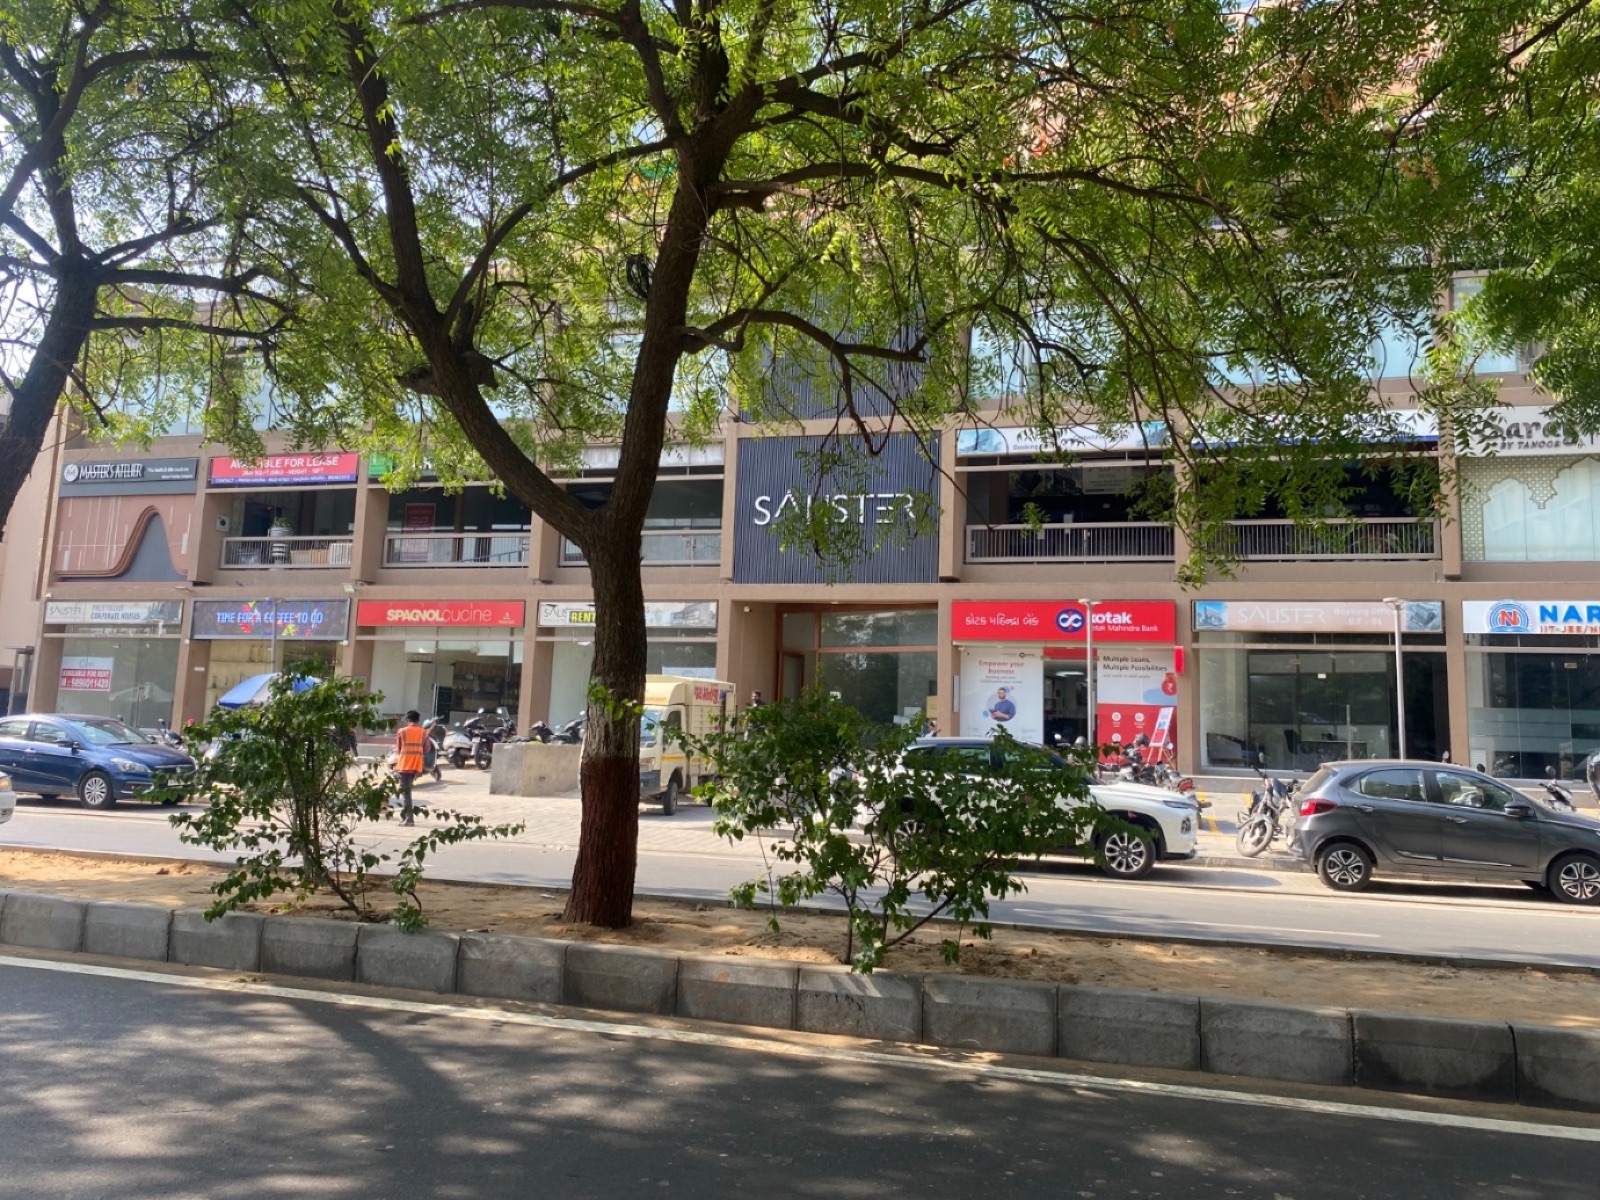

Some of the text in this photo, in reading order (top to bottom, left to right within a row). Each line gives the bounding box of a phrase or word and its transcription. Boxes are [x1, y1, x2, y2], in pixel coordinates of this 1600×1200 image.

[230, 456, 339, 469] AVBLE FOR LEASE
[216, 612, 236, 624] TIME
[297, 612, 308, 624] TO
[571, 611, 596, 624] RENT
[1238, 606, 1326, 624] SALISTER
[1107, 624, 1140, 632] Mahindra
[1141, 624, 1158, 632] Bank
[1102, 664, 1129, 672] Multiple
